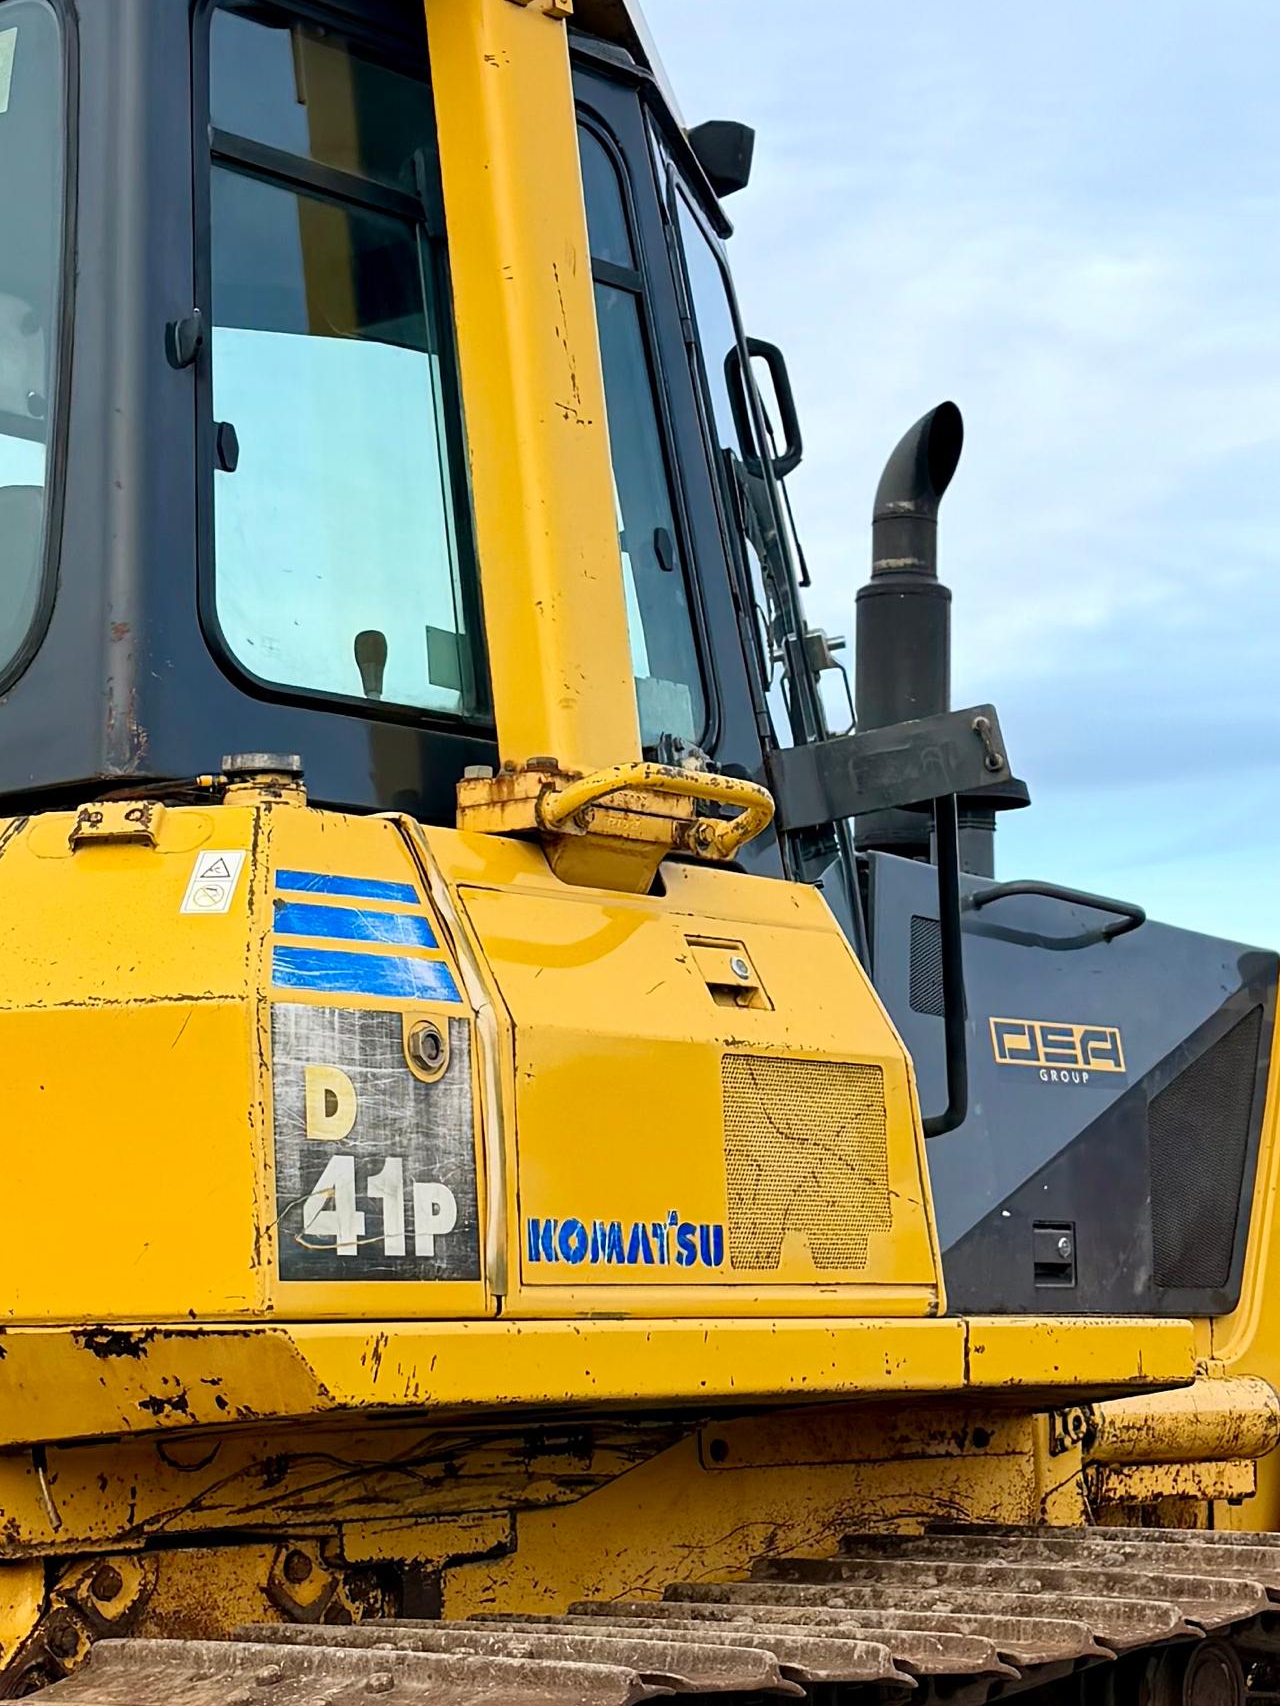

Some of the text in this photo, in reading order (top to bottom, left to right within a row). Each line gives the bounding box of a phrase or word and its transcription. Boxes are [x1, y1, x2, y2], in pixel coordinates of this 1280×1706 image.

[305, 1065, 357, 1141] D
[1039, 1069, 1089, 1084] GROUP
[302, 1155, 458, 1257] 41P
[528, 1210, 723, 1267] KOMATSU
